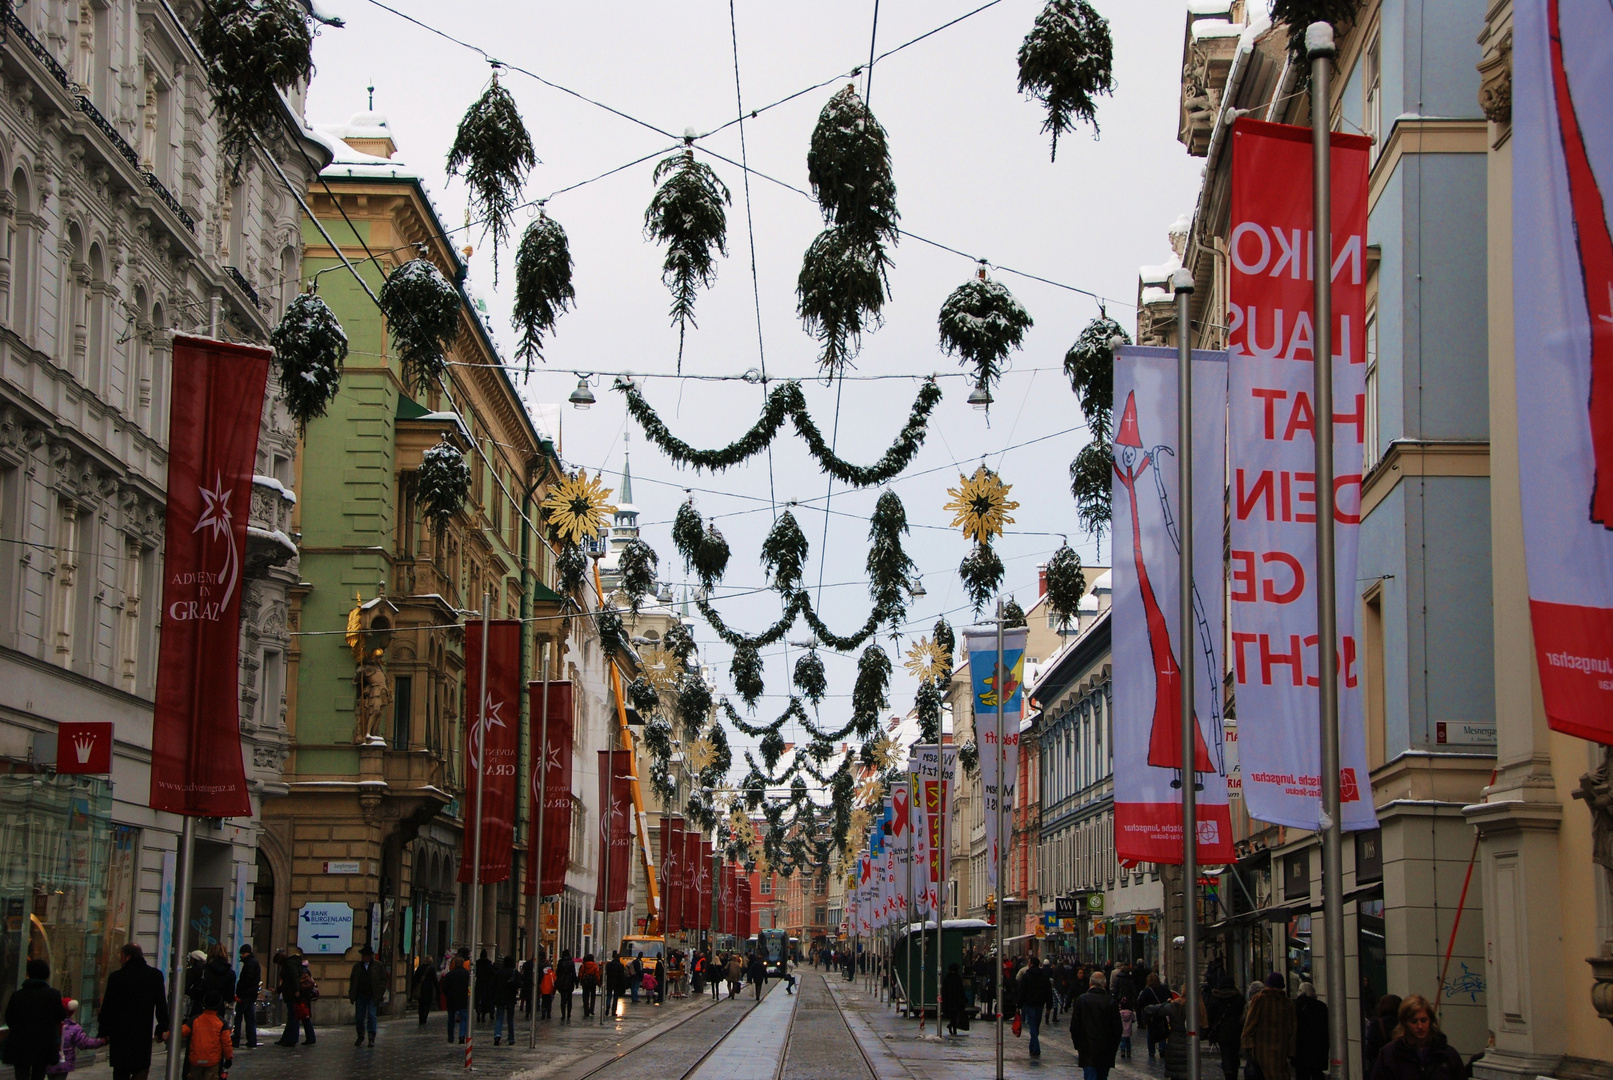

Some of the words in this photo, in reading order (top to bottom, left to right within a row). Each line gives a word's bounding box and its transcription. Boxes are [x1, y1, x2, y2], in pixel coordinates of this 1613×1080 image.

[171, 571, 217, 585] ADVENT
[199, 586, 211, 597] IN
[169, 600, 220, 622] GRAZ
